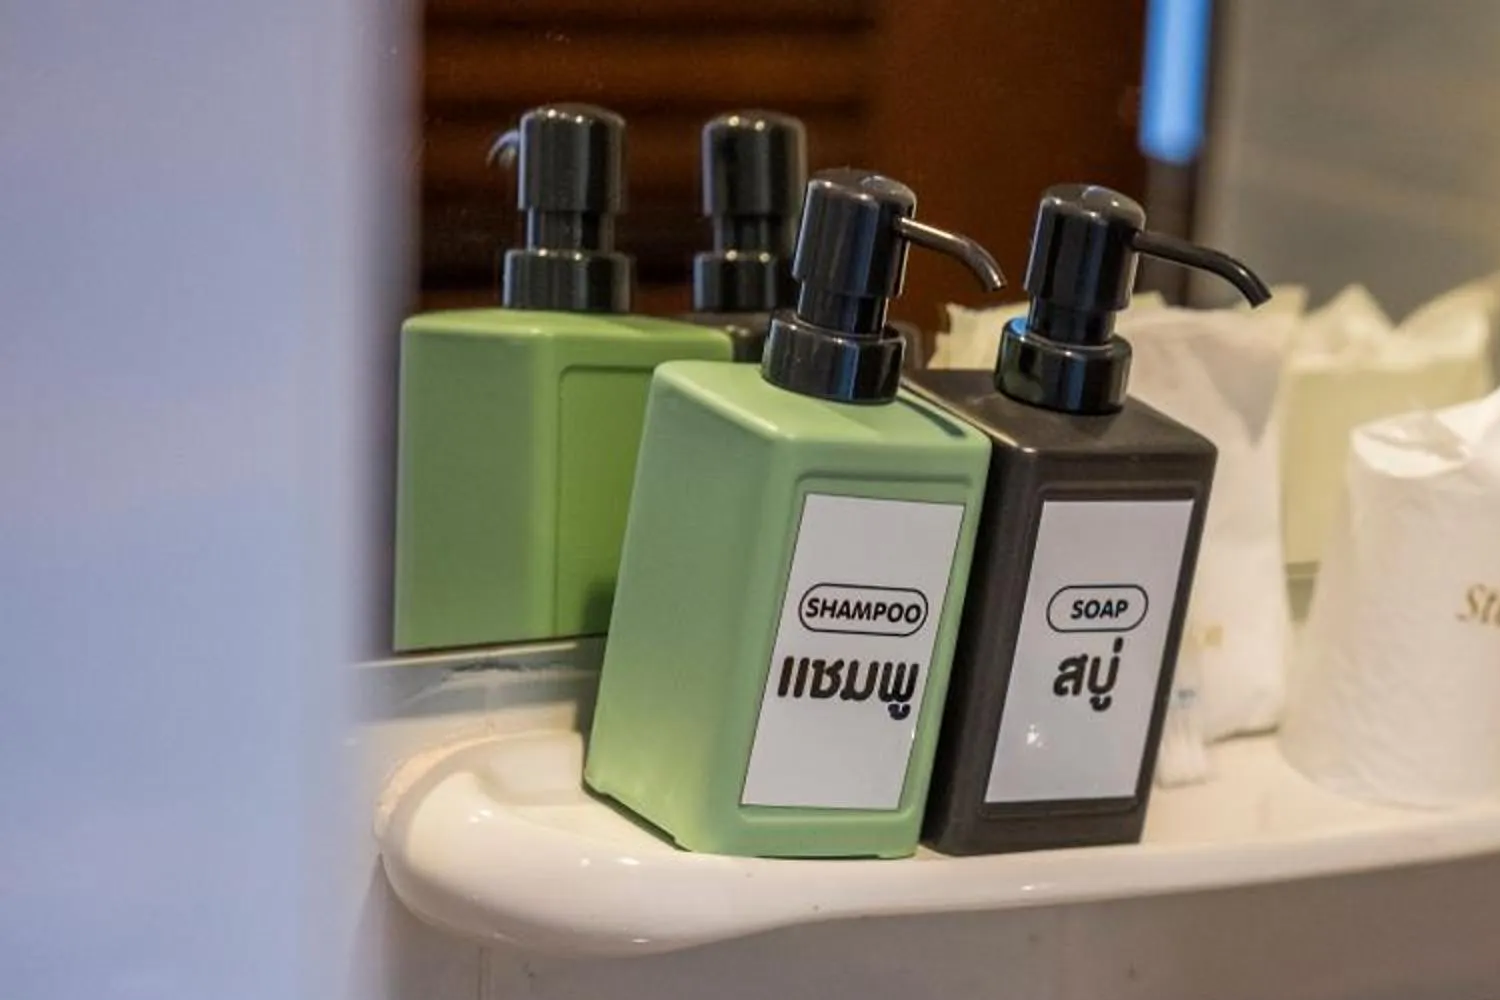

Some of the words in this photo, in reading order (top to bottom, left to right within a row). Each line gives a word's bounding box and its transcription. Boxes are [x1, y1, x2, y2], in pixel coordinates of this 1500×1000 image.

[804, 597, 922, 625] SHAMPOO
[1070, 599, 1130, 620] SOAP
[777, 656, 920, 721] แชมพู
[1052, 637, 1124, 712] สบู่
